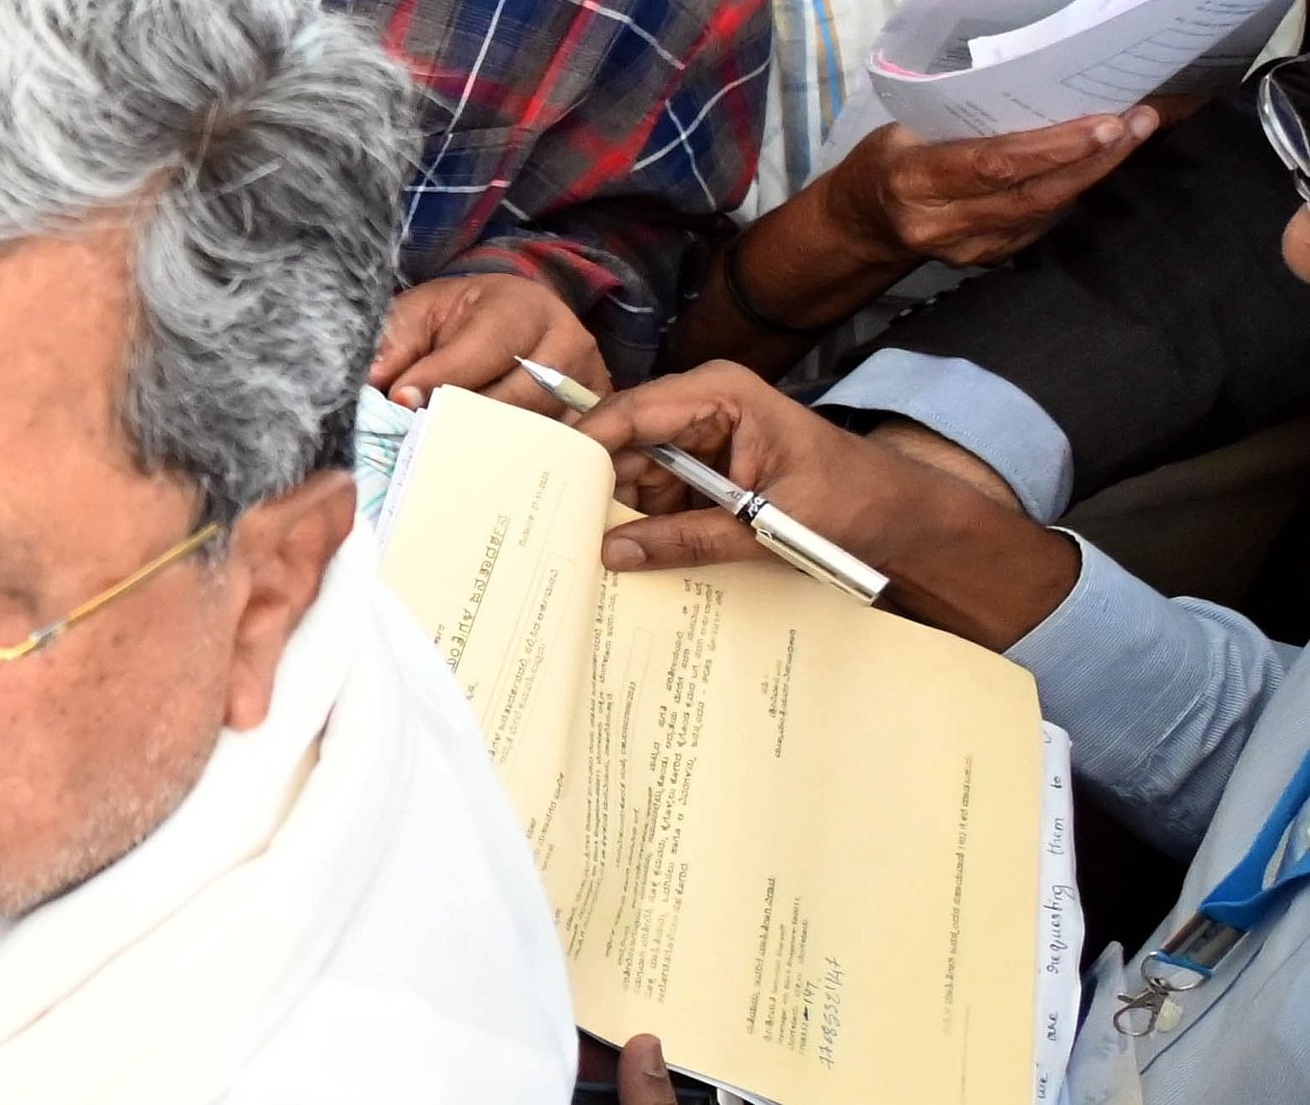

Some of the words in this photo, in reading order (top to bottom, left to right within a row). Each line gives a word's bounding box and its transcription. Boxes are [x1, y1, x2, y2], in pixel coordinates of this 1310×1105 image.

[1049, 774, 1063, 788] to
[1044, 816, 1064, 854] them
[1045, 1010, 1058, 1041] are
